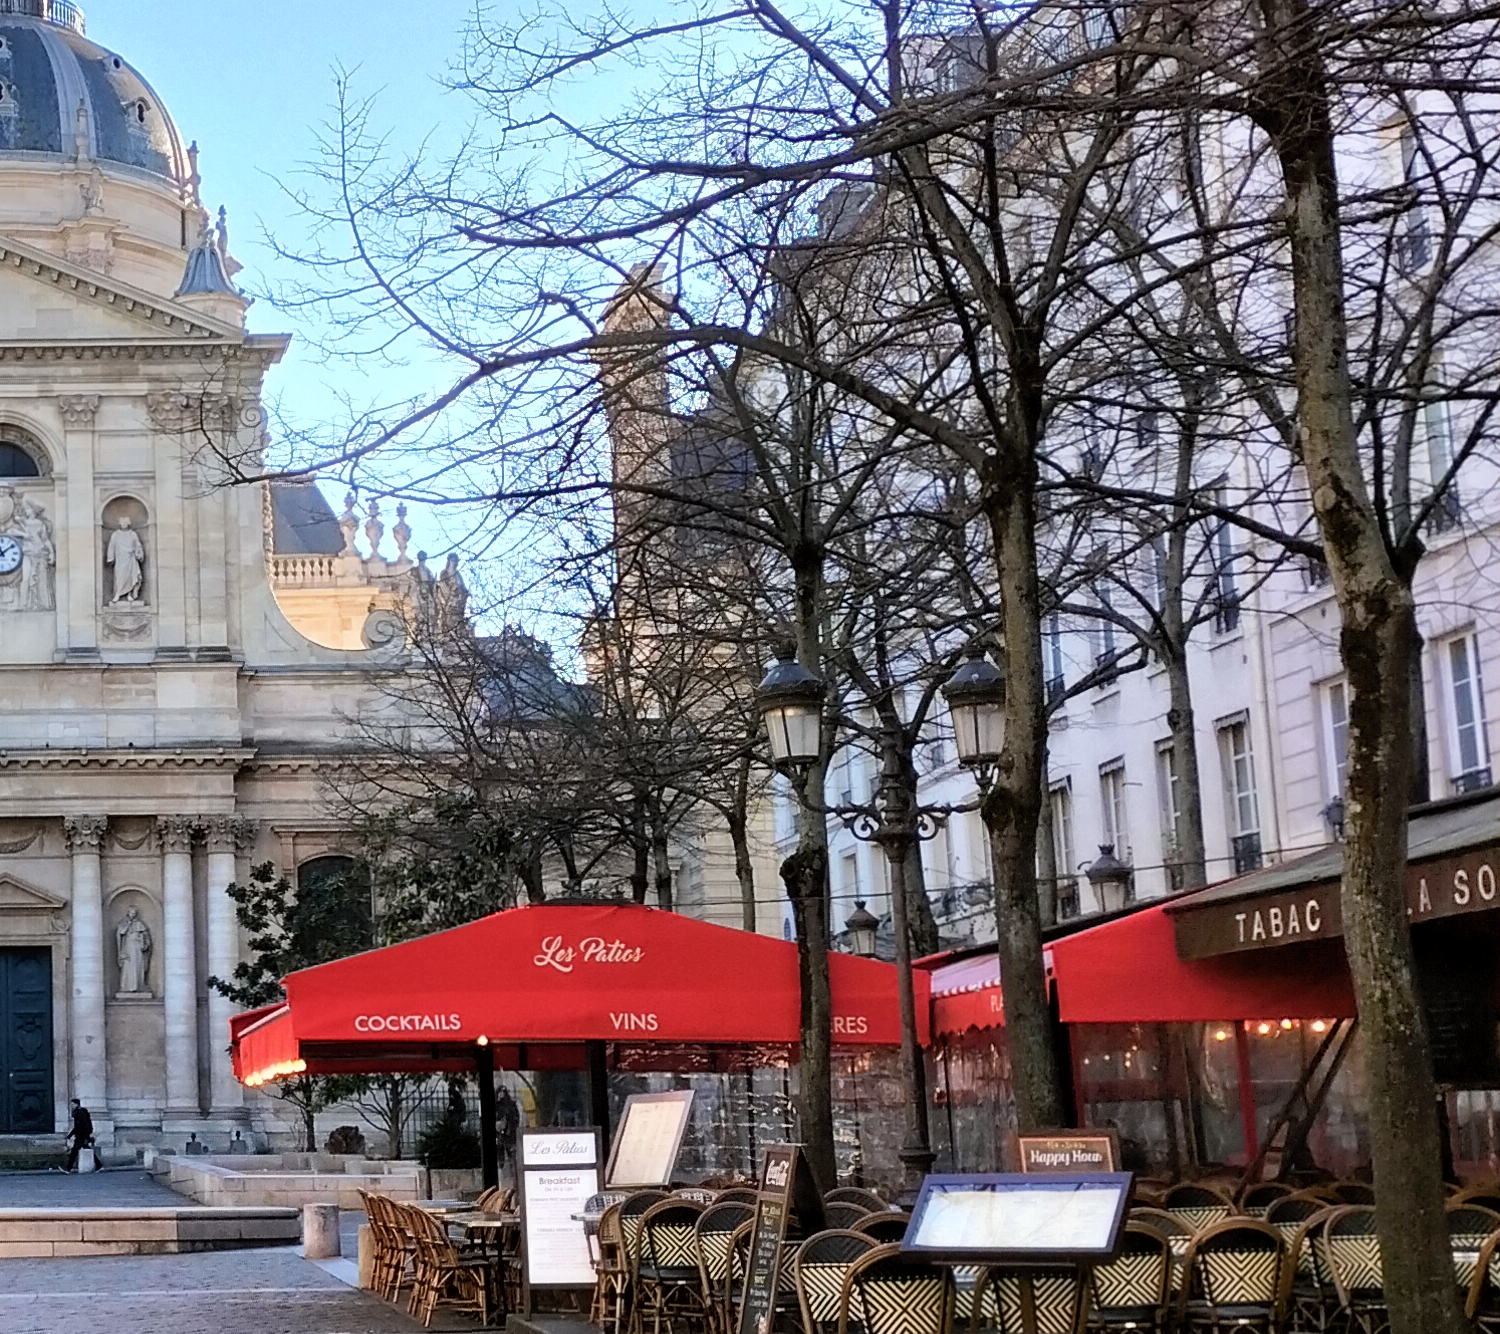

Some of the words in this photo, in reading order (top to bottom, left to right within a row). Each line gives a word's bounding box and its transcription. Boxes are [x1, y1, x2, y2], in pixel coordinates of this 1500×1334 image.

[1235, 899, 1321, 943] TABAC
[533, 935, 577, 973] Les
[579, 936, 646, 963] Patios
[354, 1013, 462, 1032] COCKTAILS
[609, 1012, 659, 1031] VINS
[830, 1016, 868, 1034] RES
[528, 1139, 551, 1155] Les
[1030, 1149, 1070, 1166] Happy
[538, 1176, 581, 1185] Breakfast
